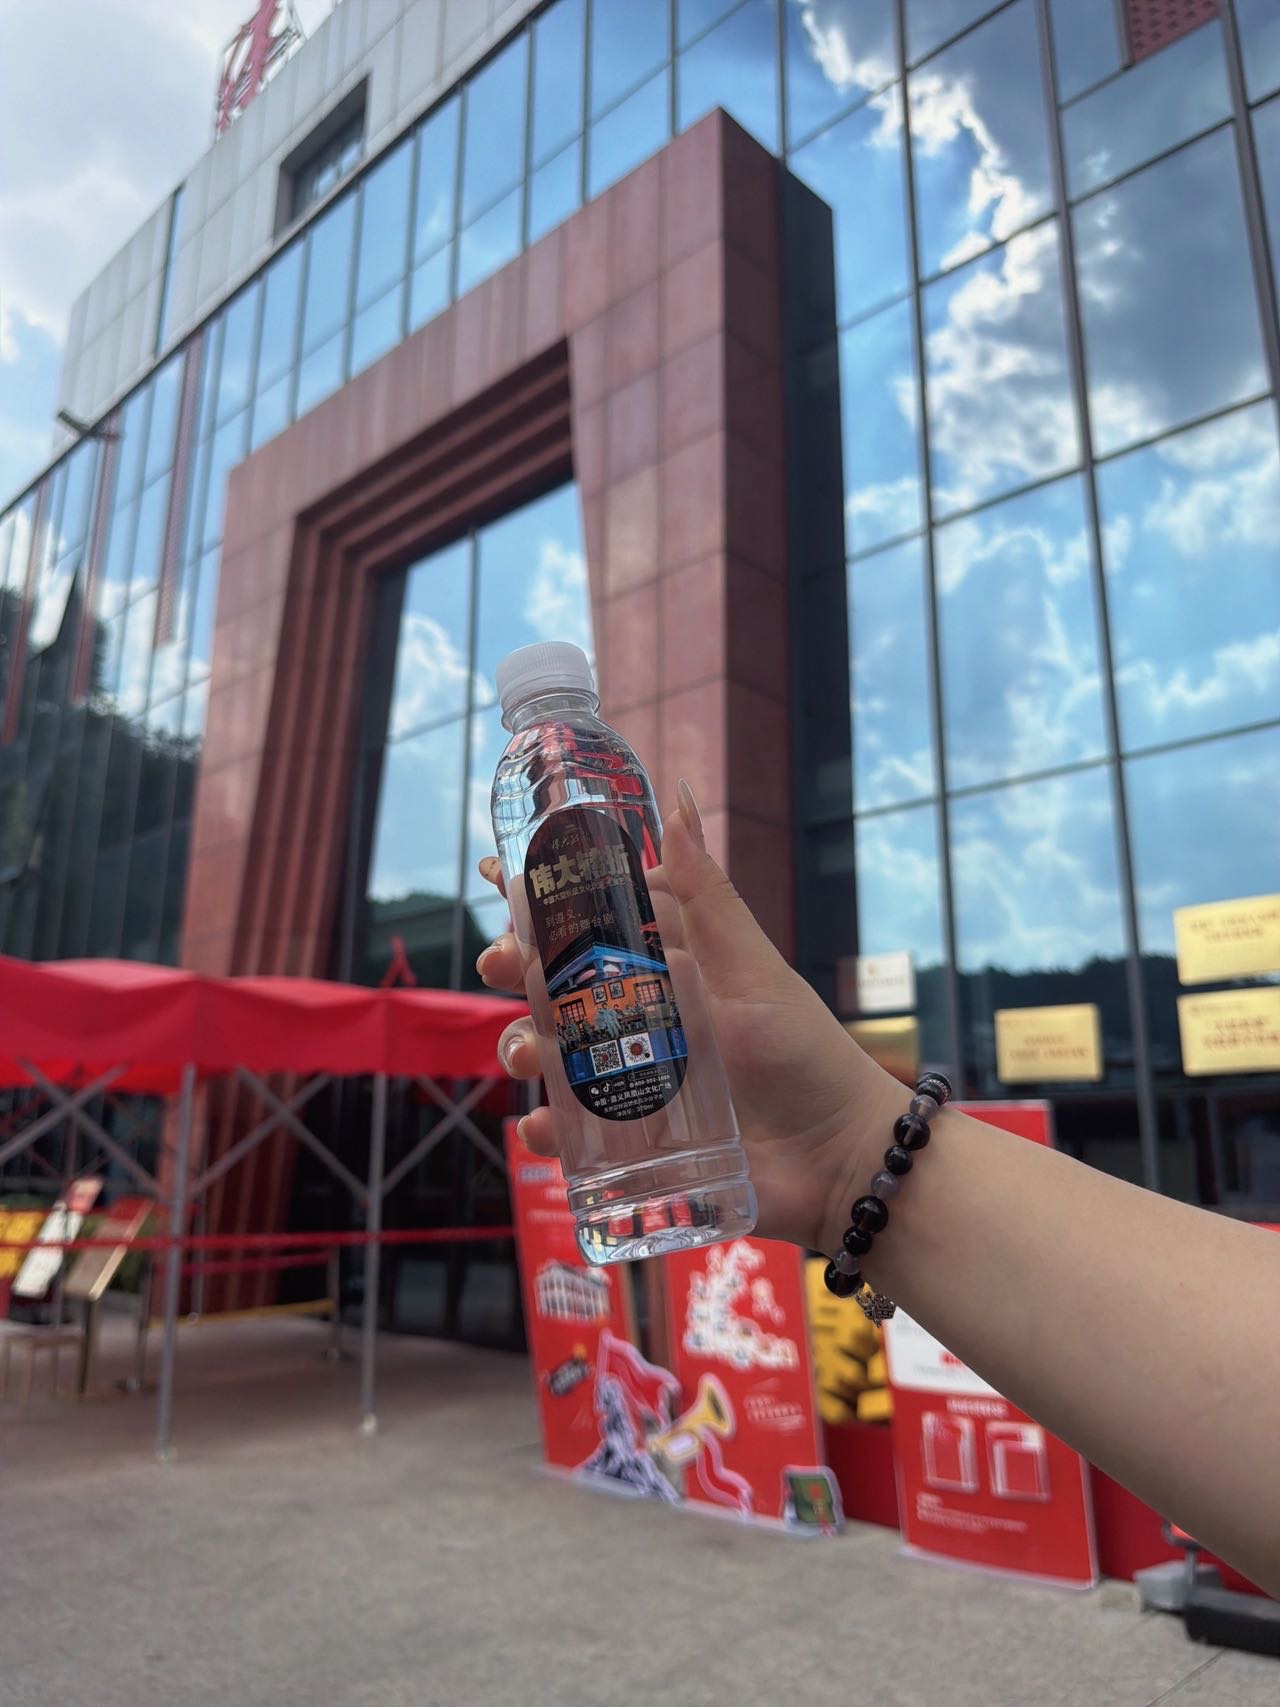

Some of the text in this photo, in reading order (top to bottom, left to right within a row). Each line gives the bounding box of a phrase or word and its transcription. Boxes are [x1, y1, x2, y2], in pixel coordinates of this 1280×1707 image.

[529, 844, 630, 899] 伟大转折
[548, 912, 615, 944] 必看的舞台剧
